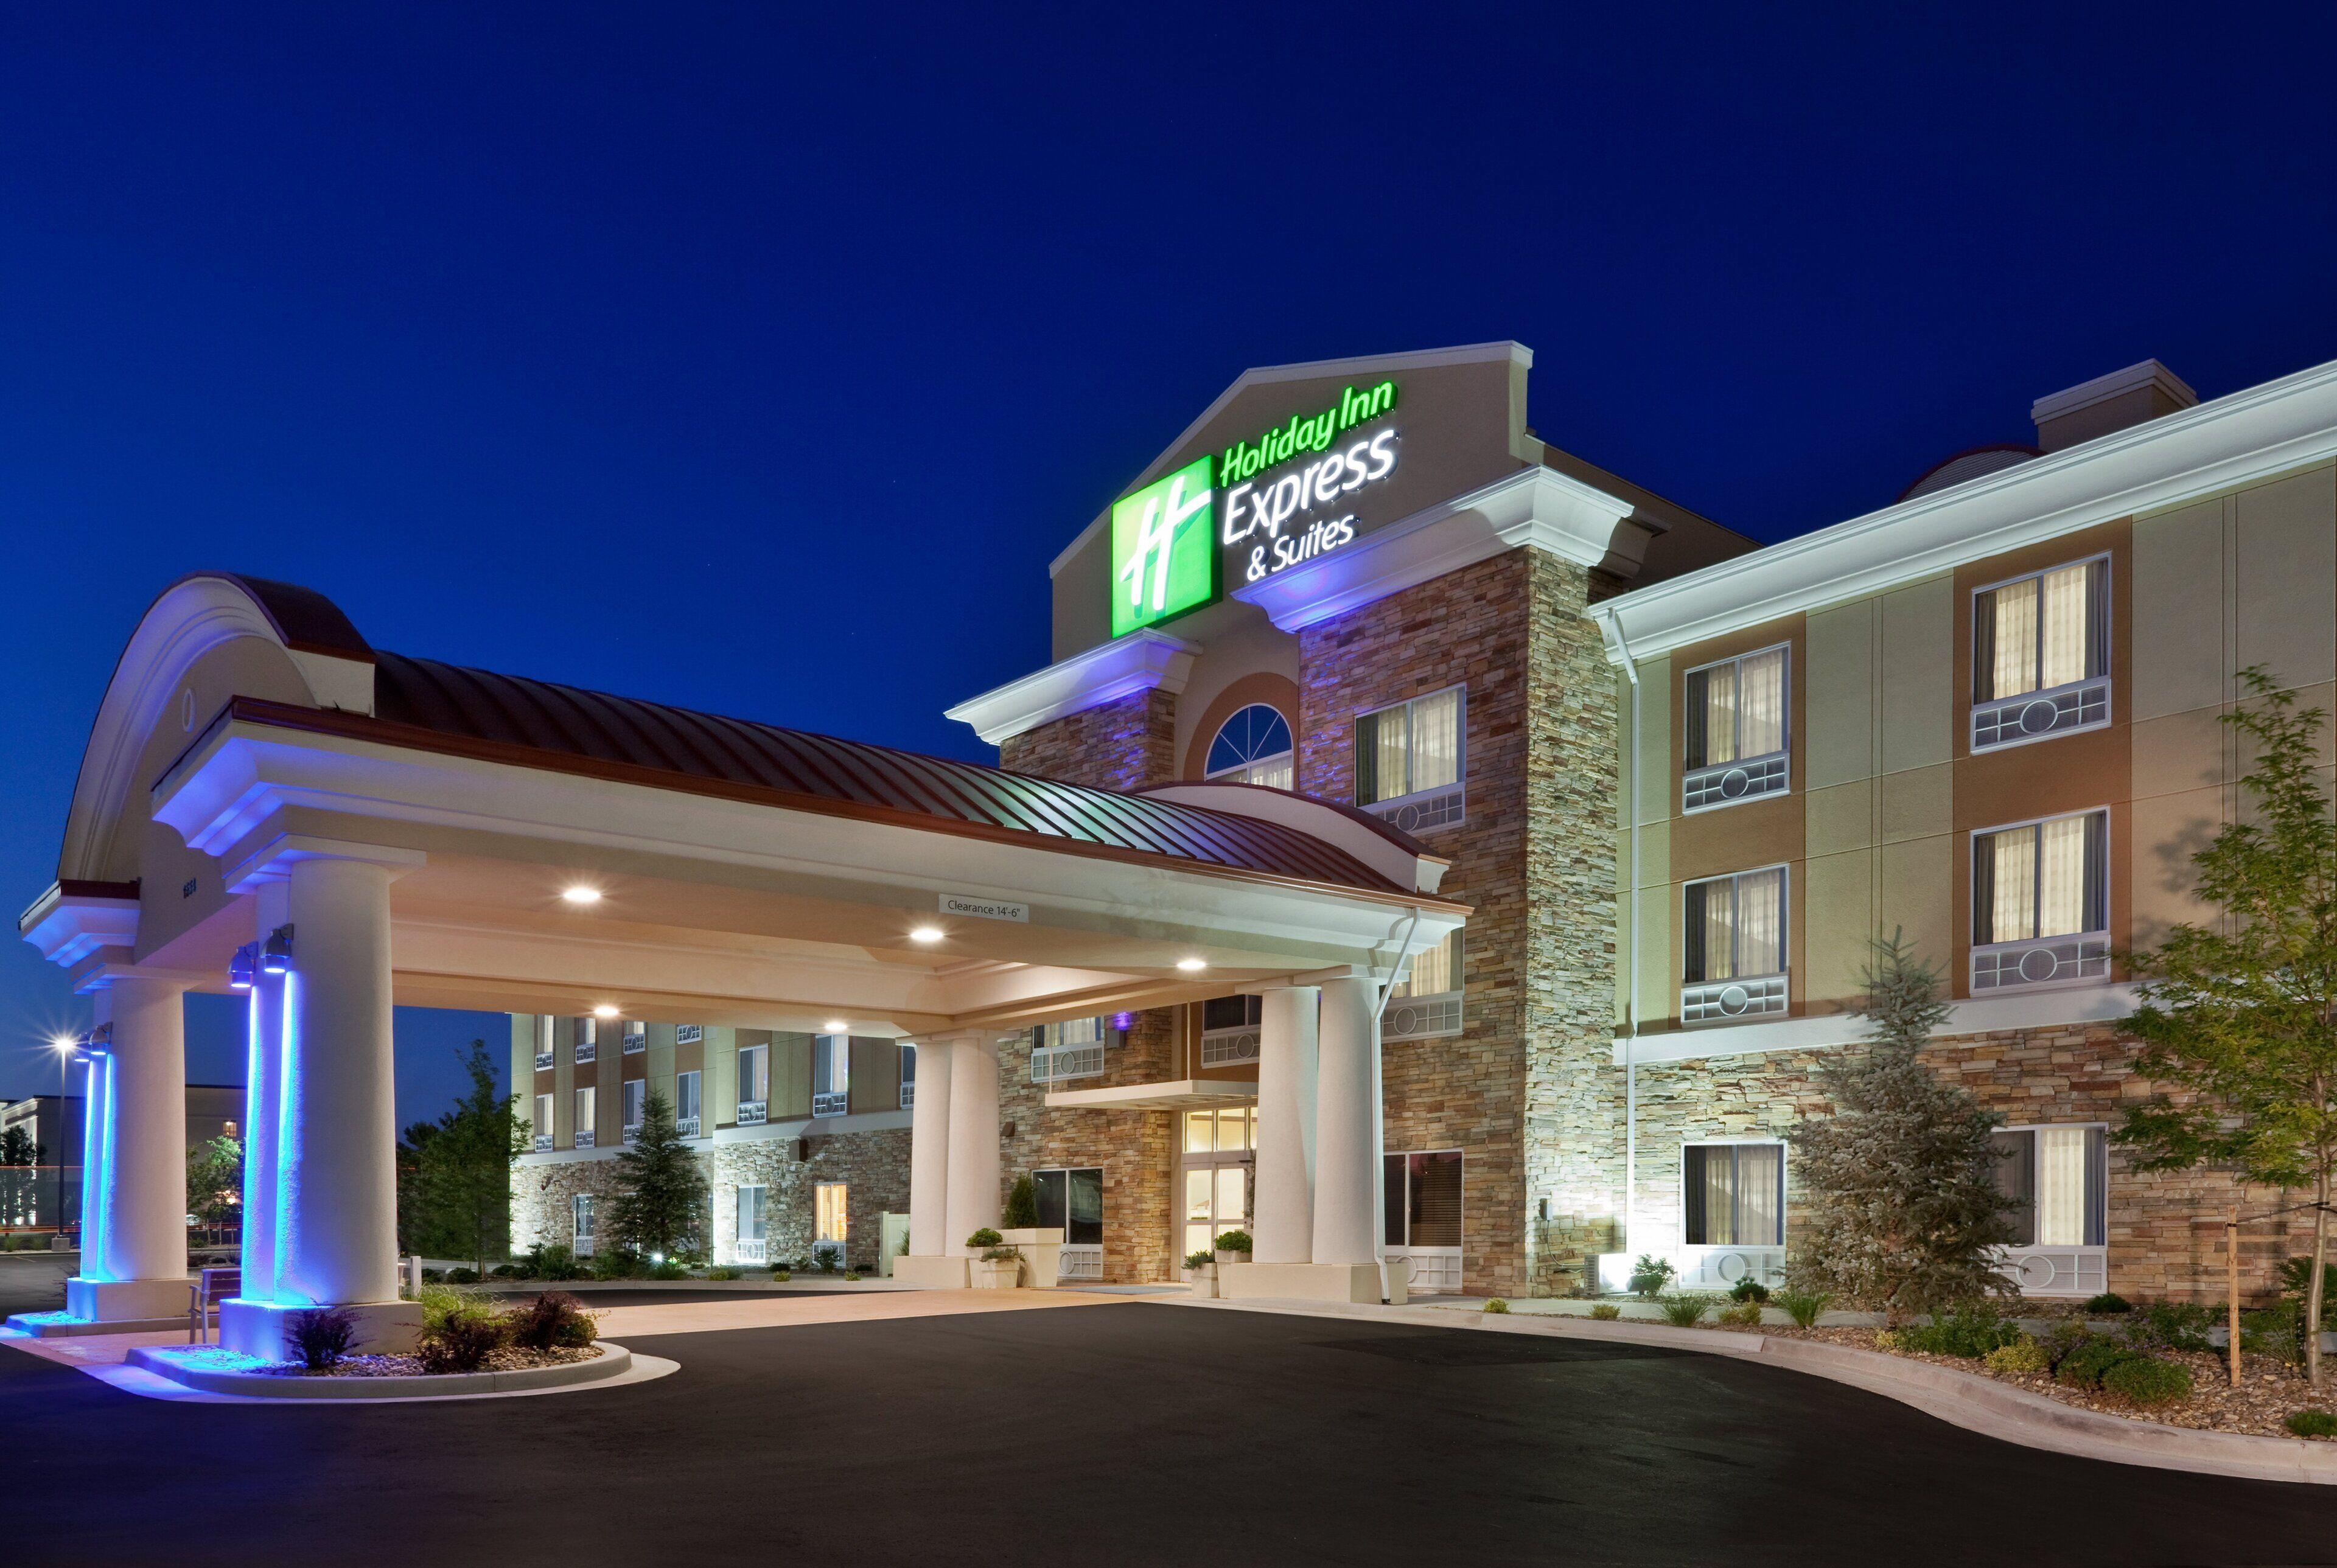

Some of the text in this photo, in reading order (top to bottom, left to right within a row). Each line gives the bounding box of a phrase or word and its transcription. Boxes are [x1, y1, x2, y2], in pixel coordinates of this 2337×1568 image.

[1220, 381, 1396, 487] Holiday Inn
[1223, 429, 1394, 545] Express
[1246, 514, 1354, 582] & Suites
[948, 899, 1021, 918] Clearance 14'-6"
